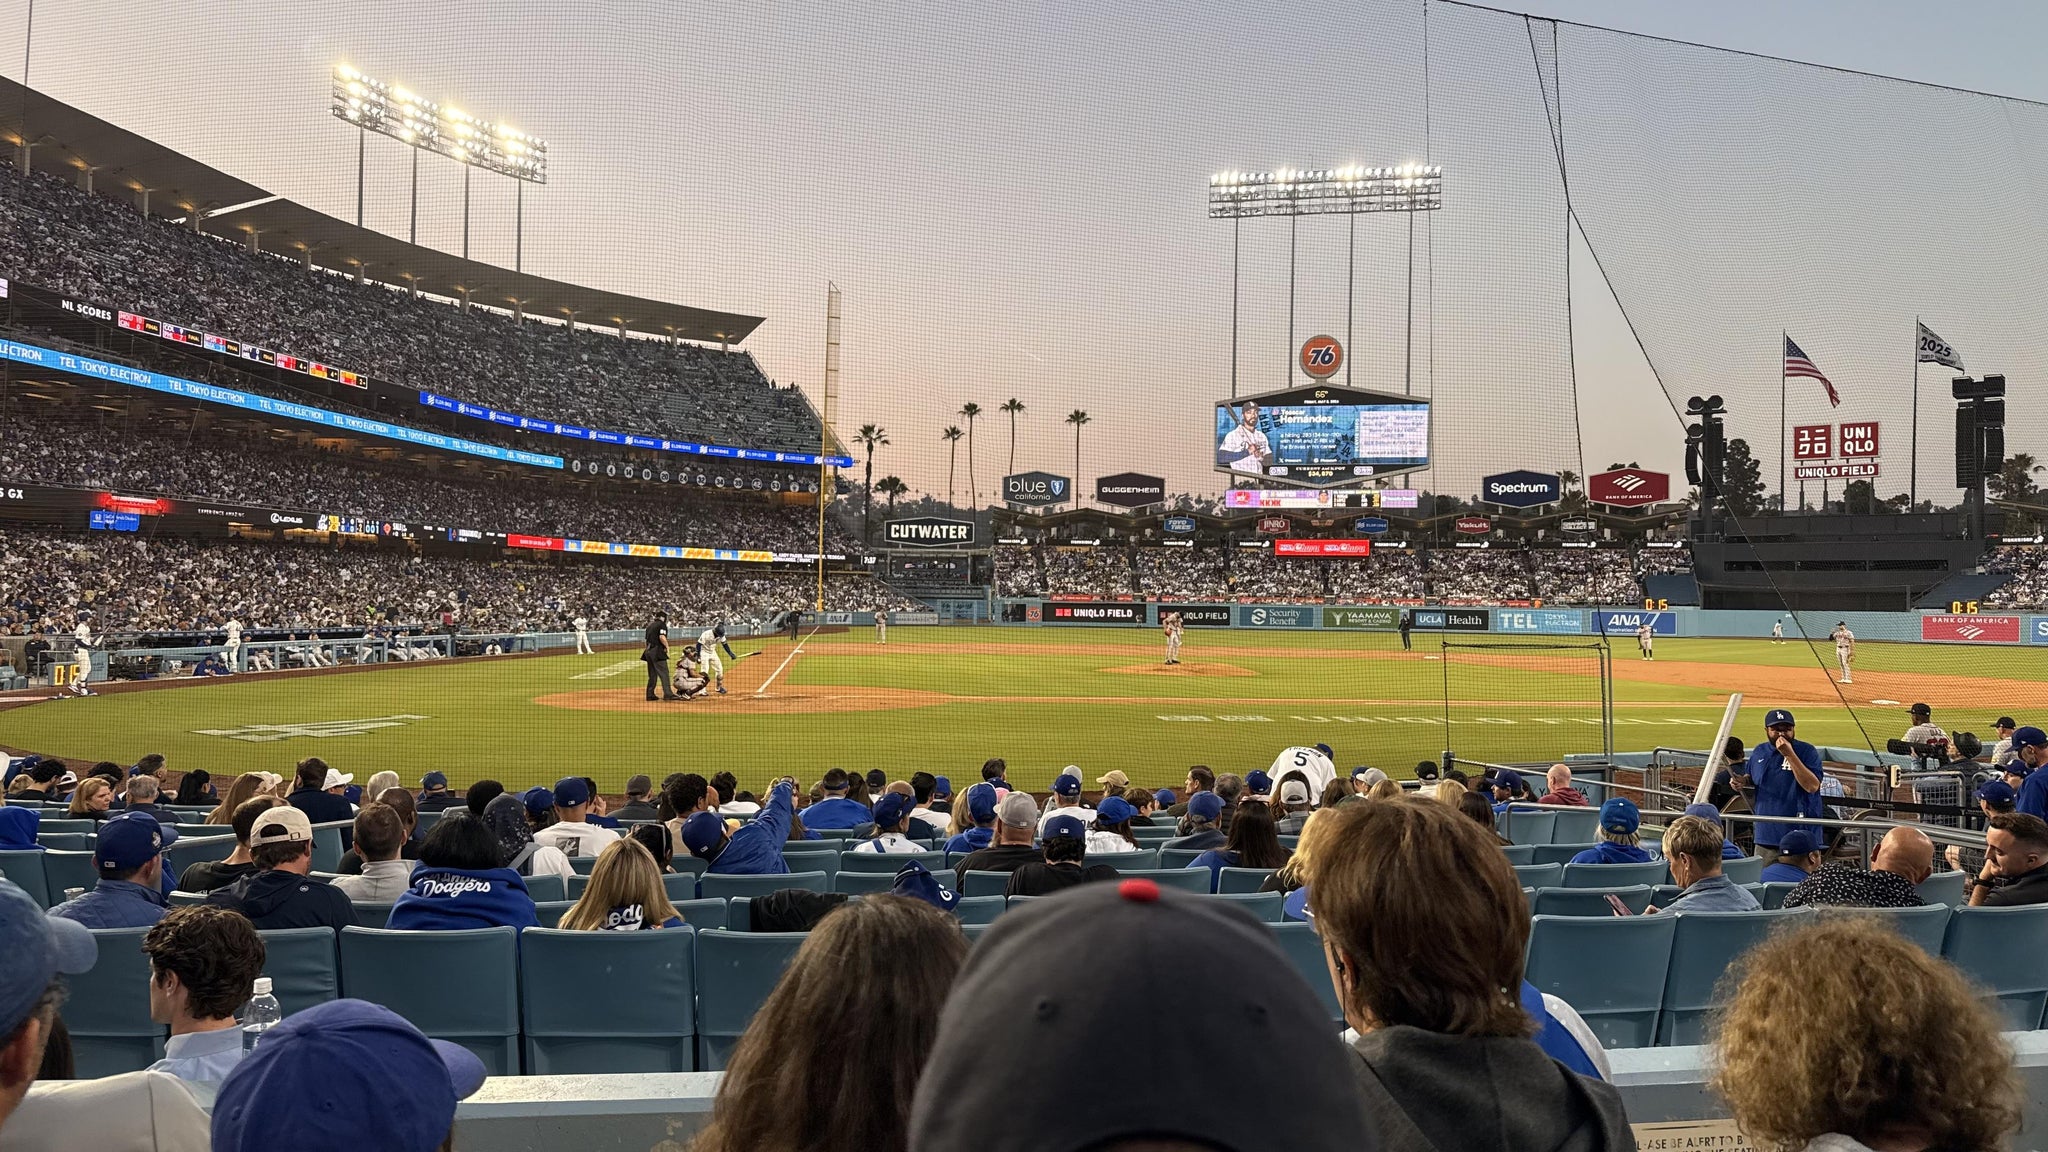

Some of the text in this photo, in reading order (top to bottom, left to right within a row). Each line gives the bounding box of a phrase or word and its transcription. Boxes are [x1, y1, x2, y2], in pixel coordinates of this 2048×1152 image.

[61, 299, 112, 321] NL SCORES
[145, 323, 158, 332] FINAL
[187, 334, 200, 343] FINAL
[226, 344, 238, 352] FINAL
[1919, 336, 1952, 358] 2025
[1308, 344, 1336, 366] 76
[59, 356, 151, 384] TEL TOKYO ELECTRON
[168, 379, 245, 404] TEL TOKYO ELECTRON
[259, 399, 324, 420] TEL TOKYO ELECTRON
[333, 415, 389, 433] TEL TOKYO ELECTRON
[1279, 415, 1333, 424] Hernández
[1844, 426, 1872, 439] UNI
[1843, 440, 1874, 455] QLO
[1797, 465, 1875, 479] UNIQLO FIELD
[1009, 477, 1047, 493] blue
[1101, 486, 1160, 494] GUGGENHEIM
[1490, 482, 1549, 497] Spectrum
[7, 488, 24, 501] GX
[1014, 492, 1051, 501] california
[279, 515, 303, 524] LEXUS
[1263, 519, 1286, 530] JINRO
[1458, 521, 1489, 529] Yakult
[890, 523, 968, 540] CUTWATER
[1645, 598, 1668, 611] 0:15
[1952, 601, 1978, 615] 0:15
[1028, 610, 1039, 619] 76
[1073, 608, 1133, 619] UNIQLO FIELD
[1183, 611, 1229, 621] IQLO FIELD
[1268, 609, 1301, 619] Security
[1543, 613, 1567, 621] TOKYO
[1268, 616, 1298, 626] Benefit
[1419, 615, 1442, 626] UCLA
[1448, 614, 1483, 626] Health
[1500, 613, 1538, 630] TEL
[1544, 619, 1580, 627] ELECTRON
[1607, 614, 1641, 628] ANA
[1932, 617, 2009, 626] BANK OF AMERICA
[1607, 627, 1635, 635] Inspiration
[1776, 711, 1784, 720] LA
[1293, 751, 1310, 767] 5
[423, 880, 492, 898] Dodgers
[1719, 1135, 1734, 1147] TO
